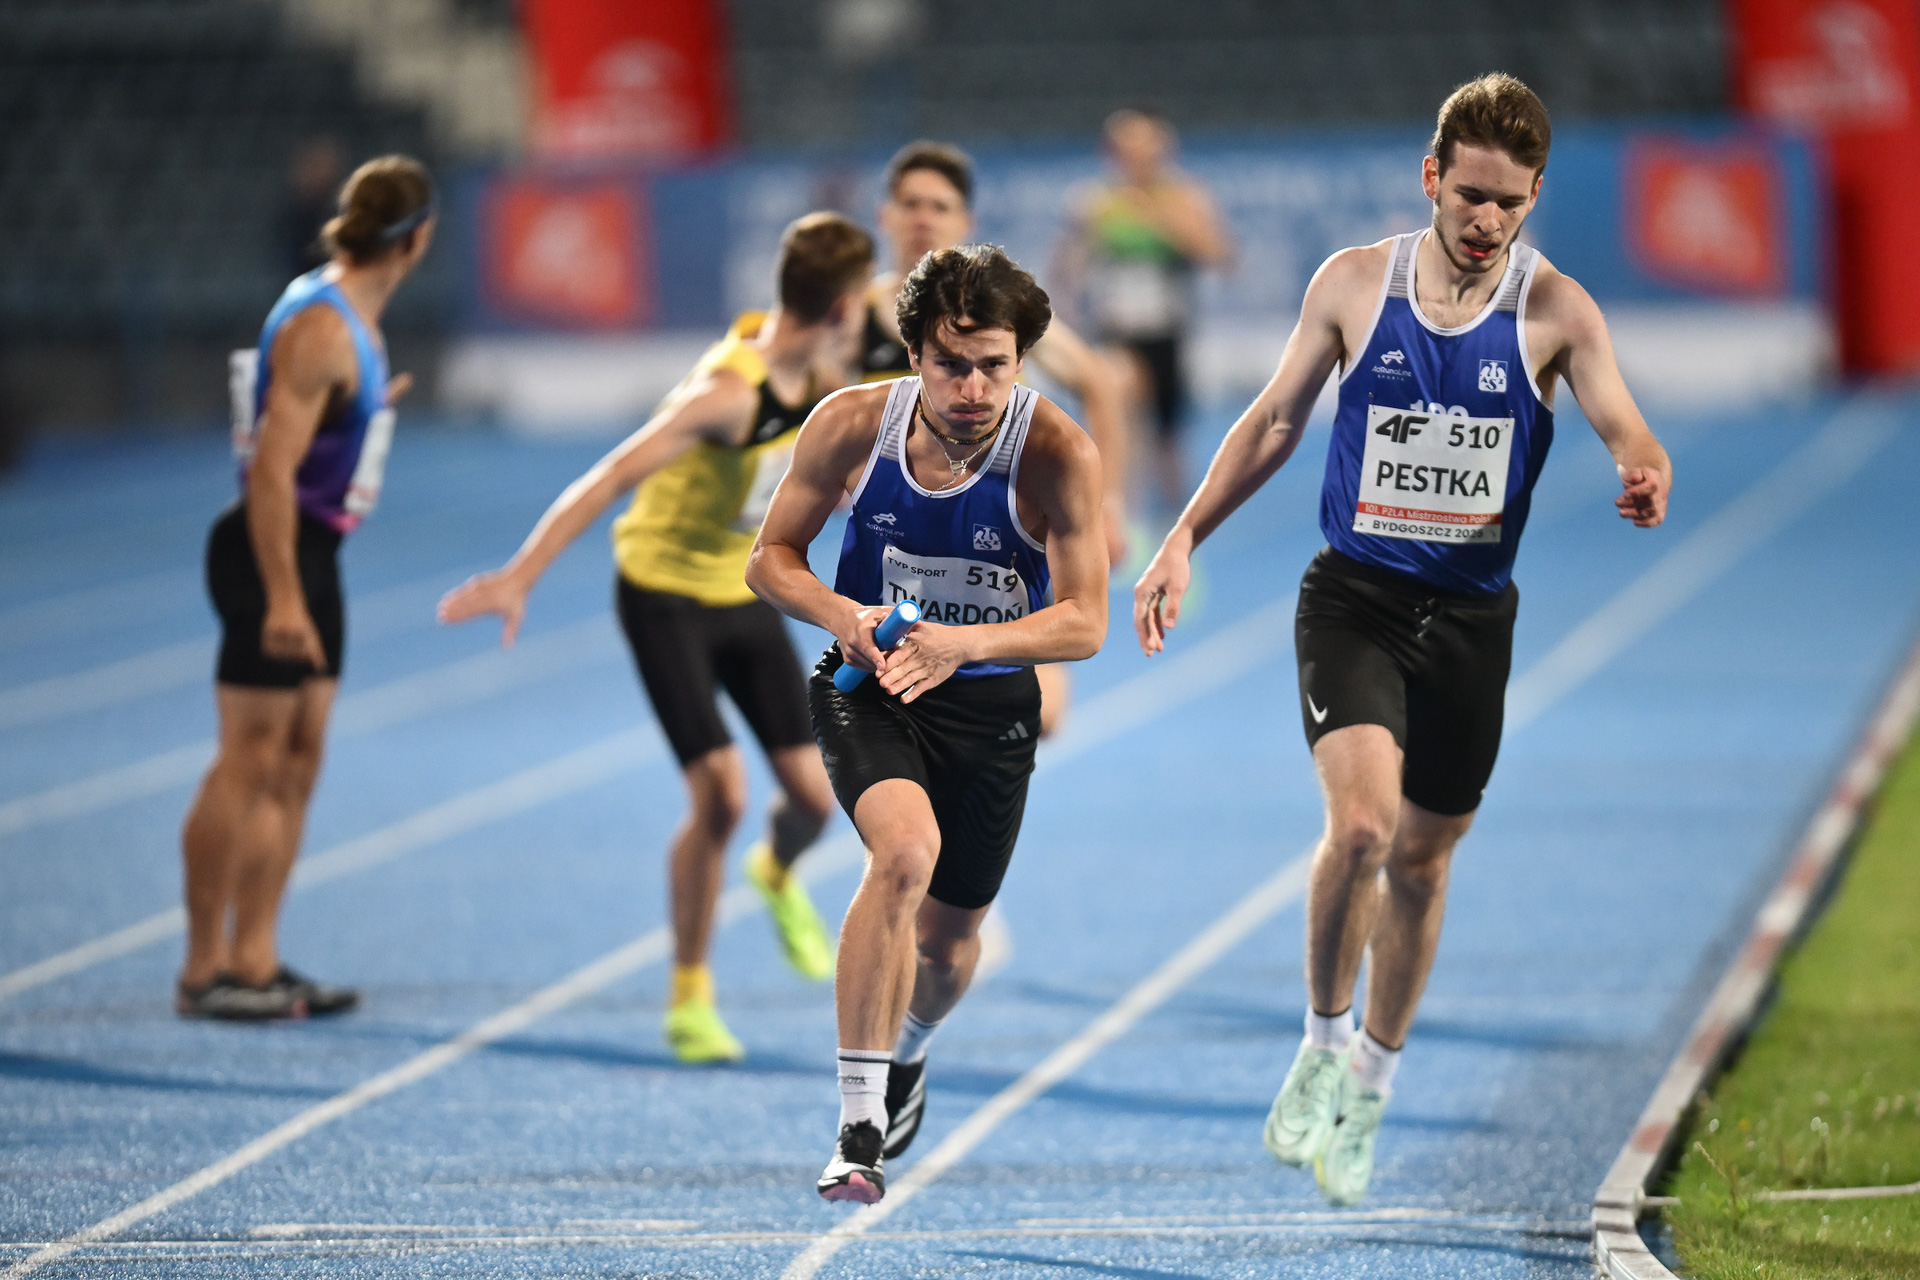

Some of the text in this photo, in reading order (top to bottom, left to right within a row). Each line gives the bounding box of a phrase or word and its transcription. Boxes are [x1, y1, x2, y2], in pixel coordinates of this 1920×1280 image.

[1375, 413, 1500, 449] 4F 510
[1376, 459, 1491, 497] PESTKA
[1373, 519, 1484, 538] BYDGOSZCZ 2025
[1382, 506, 1405, 518] PZLA
[1407, 510, 1468, 523] Mistrzostwa
[888, 556, 1018, 593] TVP SPORT 519
